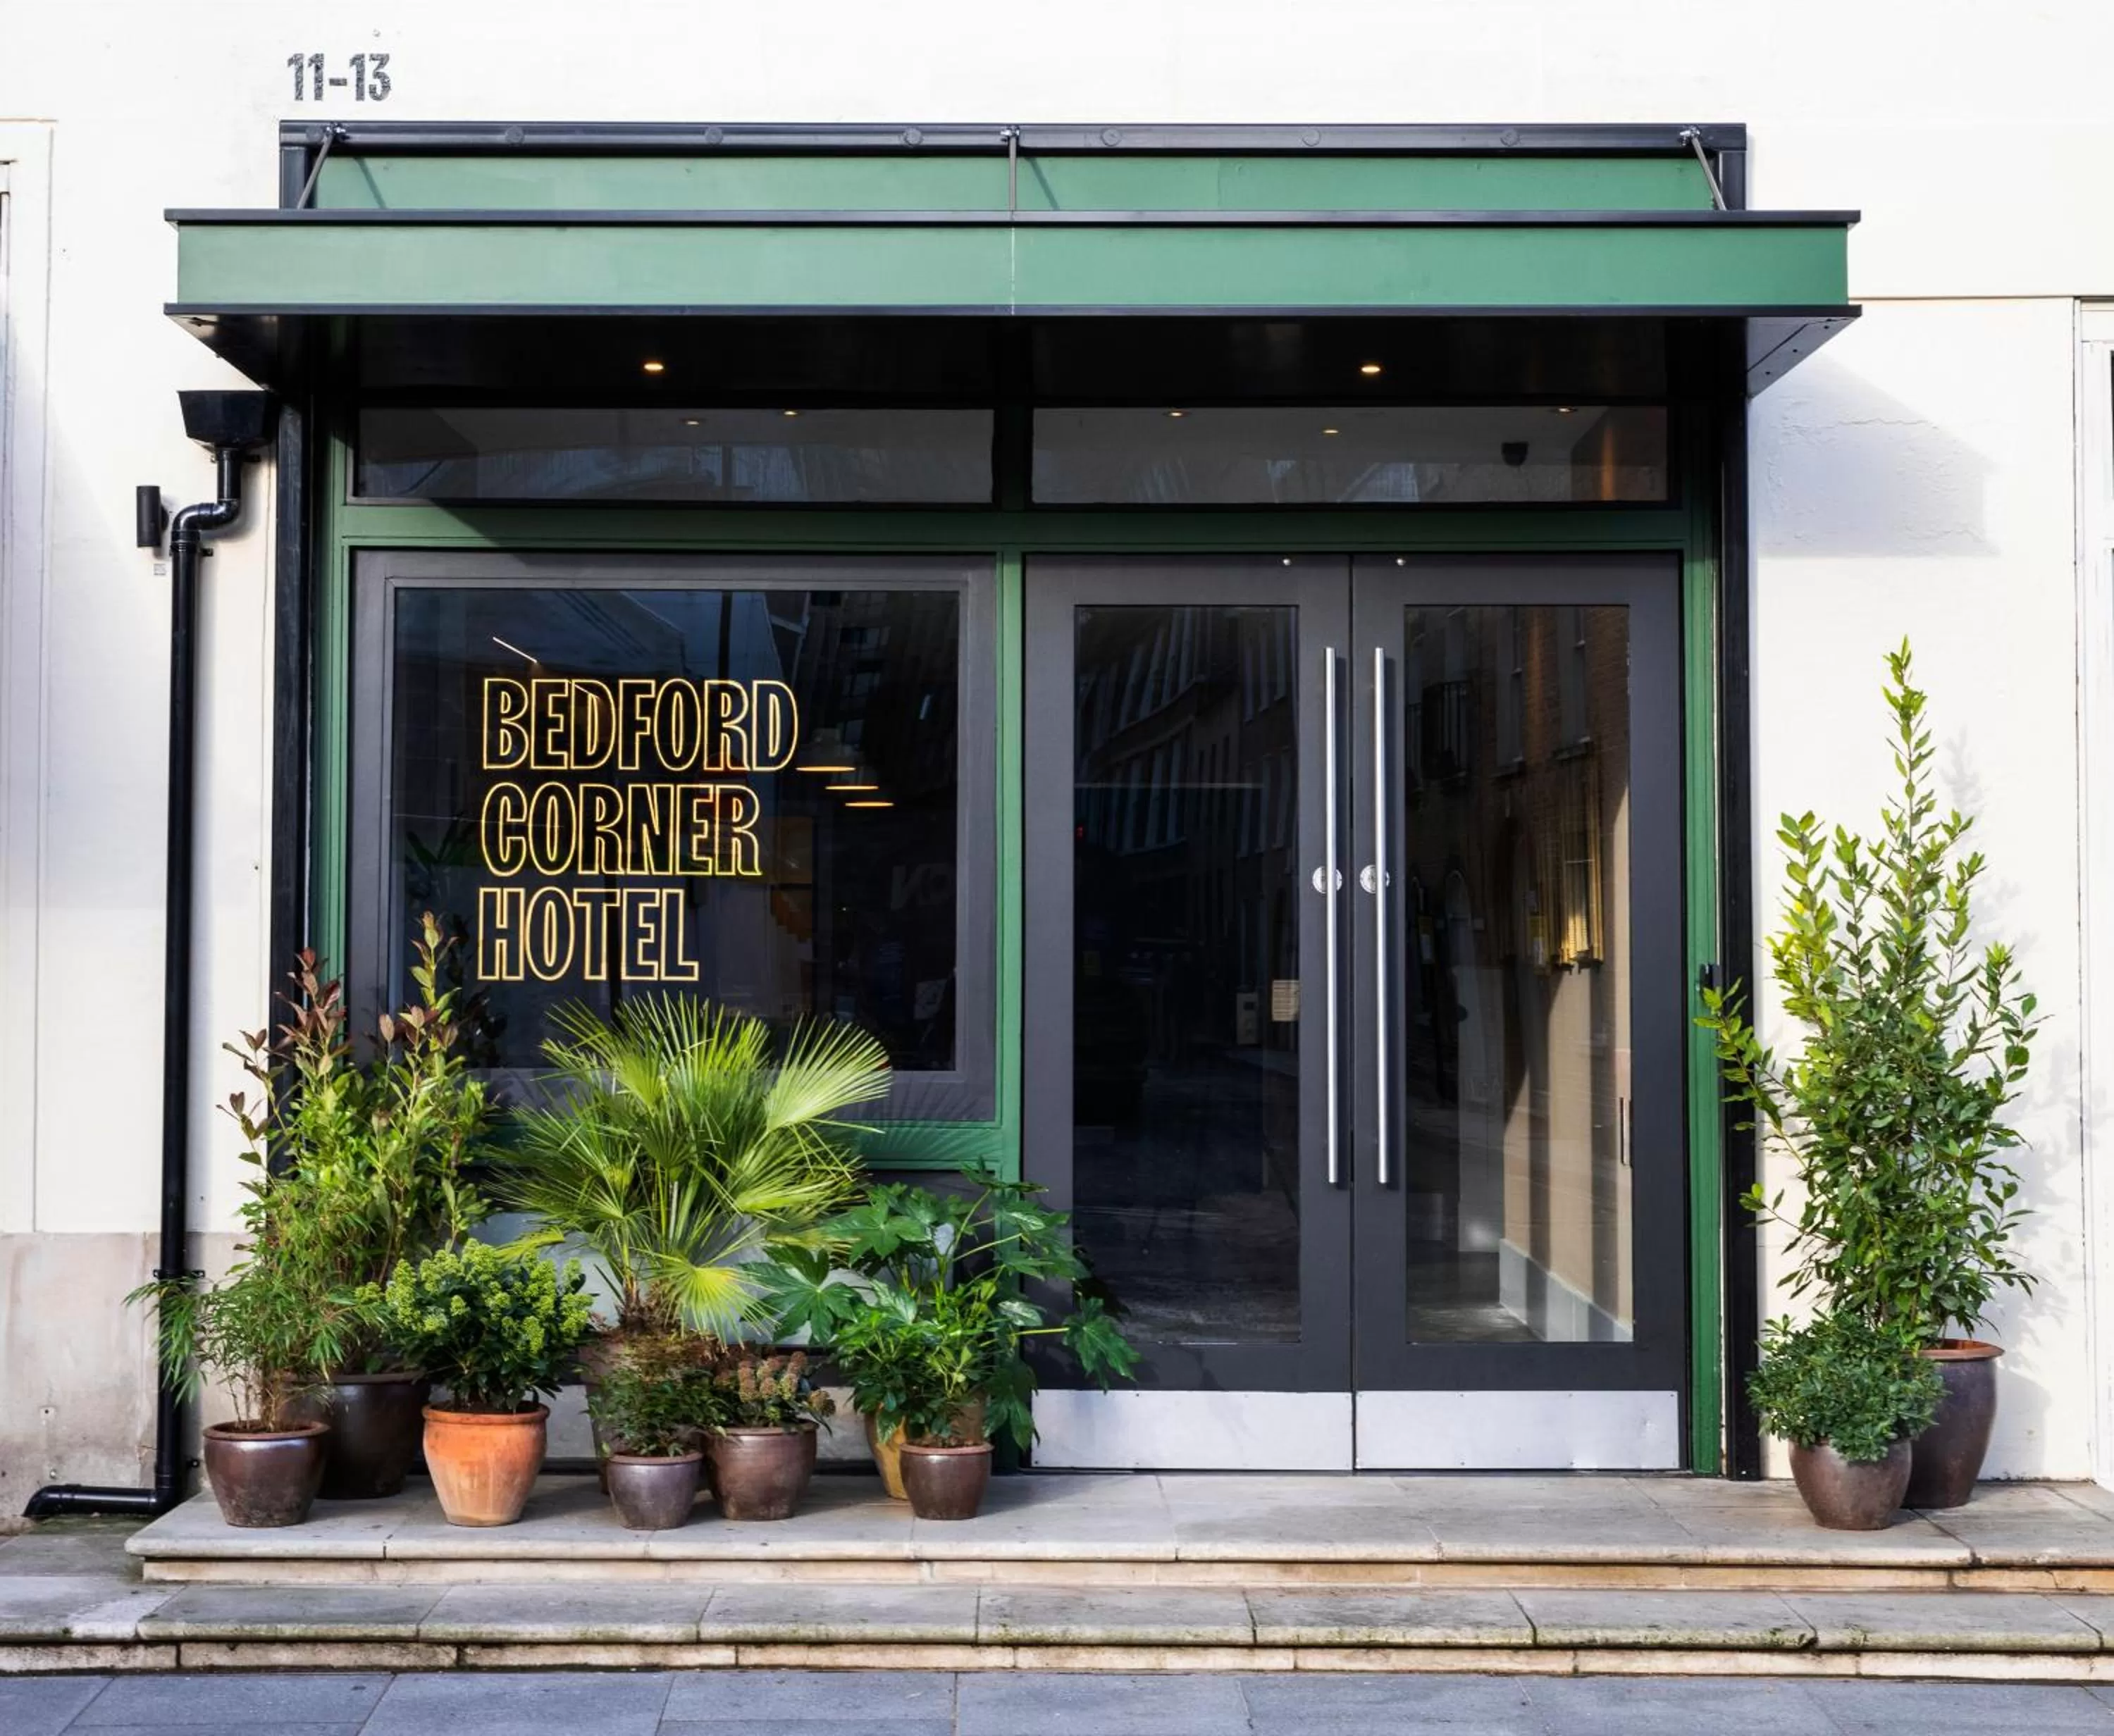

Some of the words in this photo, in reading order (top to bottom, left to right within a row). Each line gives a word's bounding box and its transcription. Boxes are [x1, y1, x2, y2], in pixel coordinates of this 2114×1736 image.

[287, 53, 392, 101] 11-13
[483, 678, 799, 771] BEDFORD
[481, 781, 763, 877] CORNER
[477, 886, 700, 981] HOTEL
